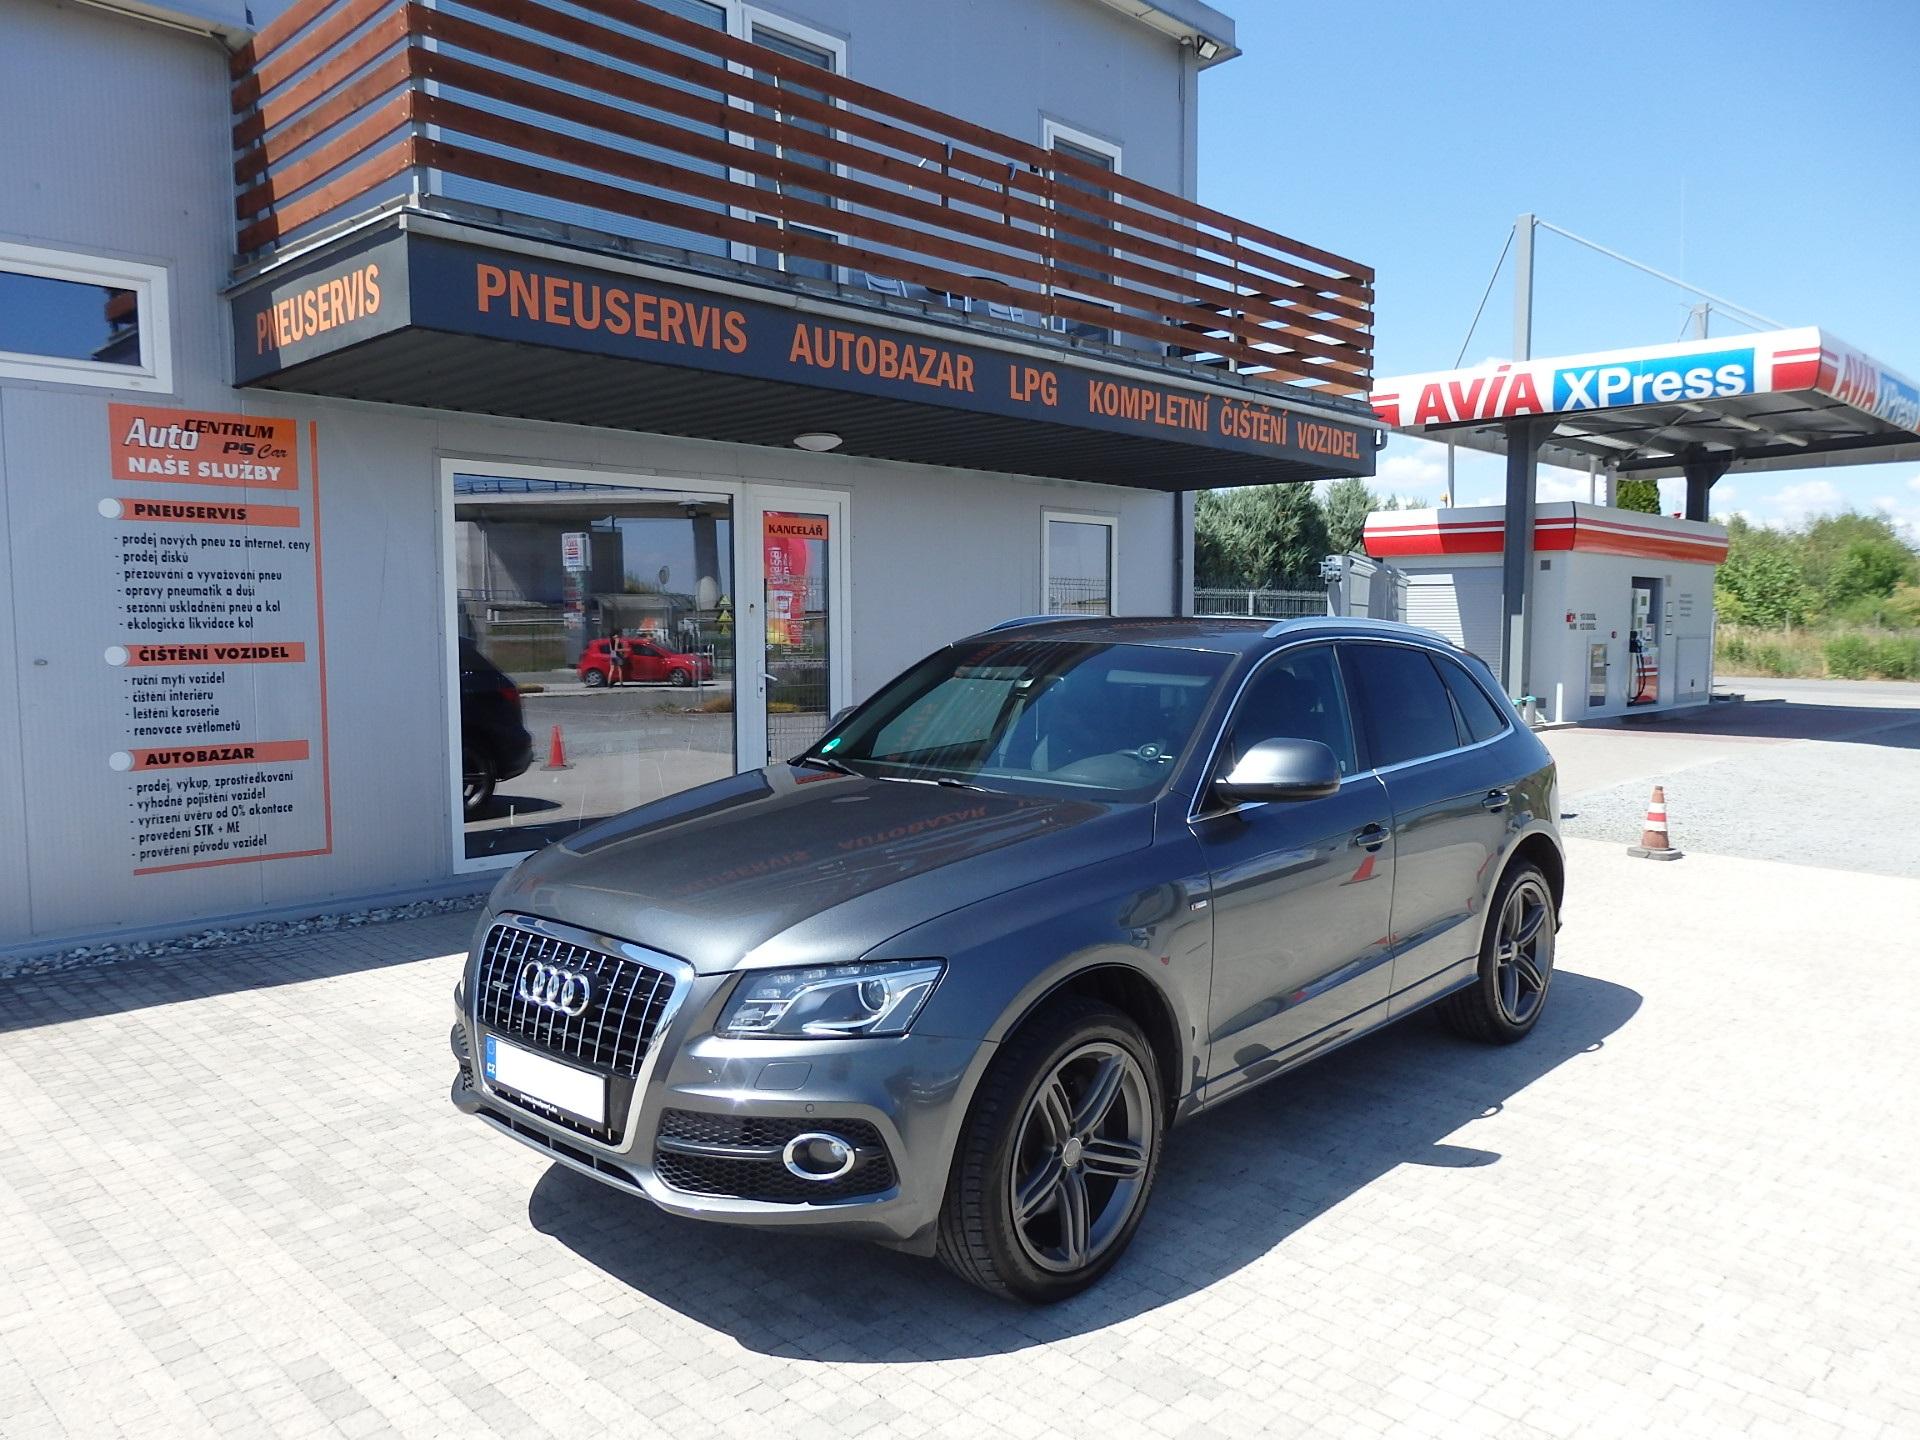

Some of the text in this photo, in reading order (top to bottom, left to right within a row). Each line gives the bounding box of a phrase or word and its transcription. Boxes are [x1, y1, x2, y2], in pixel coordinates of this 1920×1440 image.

[256, 263, 381, 355] PNEUSERVIS
[476, 263, 1361, 460] PNEUSERVIS AUTOBAZAR LPG KOMPLETNÍ ČIŠTĚNÍ VOZIDEL
[1413, 362, 1748, 426] AVIA XPress
[124, 417, 199, 450] Auto
[185, 419, 274, 440] CENTRUM
[222, 441, 288, 459] PS Car
[128, 456, 281, 482] NAŠE SLUŽBY
[134, 503, 247, 520] PNEUSERVIS
[768, 524, 823, 537] KANCELÁŘ
[122, 532, 311, 553] prodej nových pneu za internet. ceny
[123, 550, 158, 567] prodej
[124, 569, 282, 583] přezouvání a vyvažování pneu
[125, 587, 163, 599] opravy
[167, 584, 222, 598] pneumatik
[226, 588, 233, 597] a
[169, 600, 226, 613] uskladnění
[229, 603, 253, 615] pneu
[256, 604, 262, 613] a
[265, 600, 281, 612] kol
[127, 616, 254, 632] ekologická likvidace kol
[139, 644, 289, 662] ČIŠTĚNÍ VOZIDEL
[131, 674, 158, 686] ruční
[188, 671, 225, 684] vozidel
[132, 688, 214, 703] čištění interiéru
[133, 705, 220, 719] leštění karoserie
[134, 719, 241, 737] renovace světlometů
[145, 747, 255, 766] AUTOBAZAR
[136, 778, 172, 796] prodej,
[214, 770, 294, 789] zprostředkování
[137, 787, 266, 812] výhodné pojištění vozidel
[138, 812, 181, 828] vyřízení
[216, 806, 228, 818] od
[231, 804, 246, 817] 0%
[249, 803, 294, 816] akontace
[139, 829, 191, 844] provedení
[194, 823, 214, 837] STK
[226, 821, 240, 834] ME
[139, 833, 267, 862] prověření původu vozidel
[487, 1062, 496, 1074] CZ
